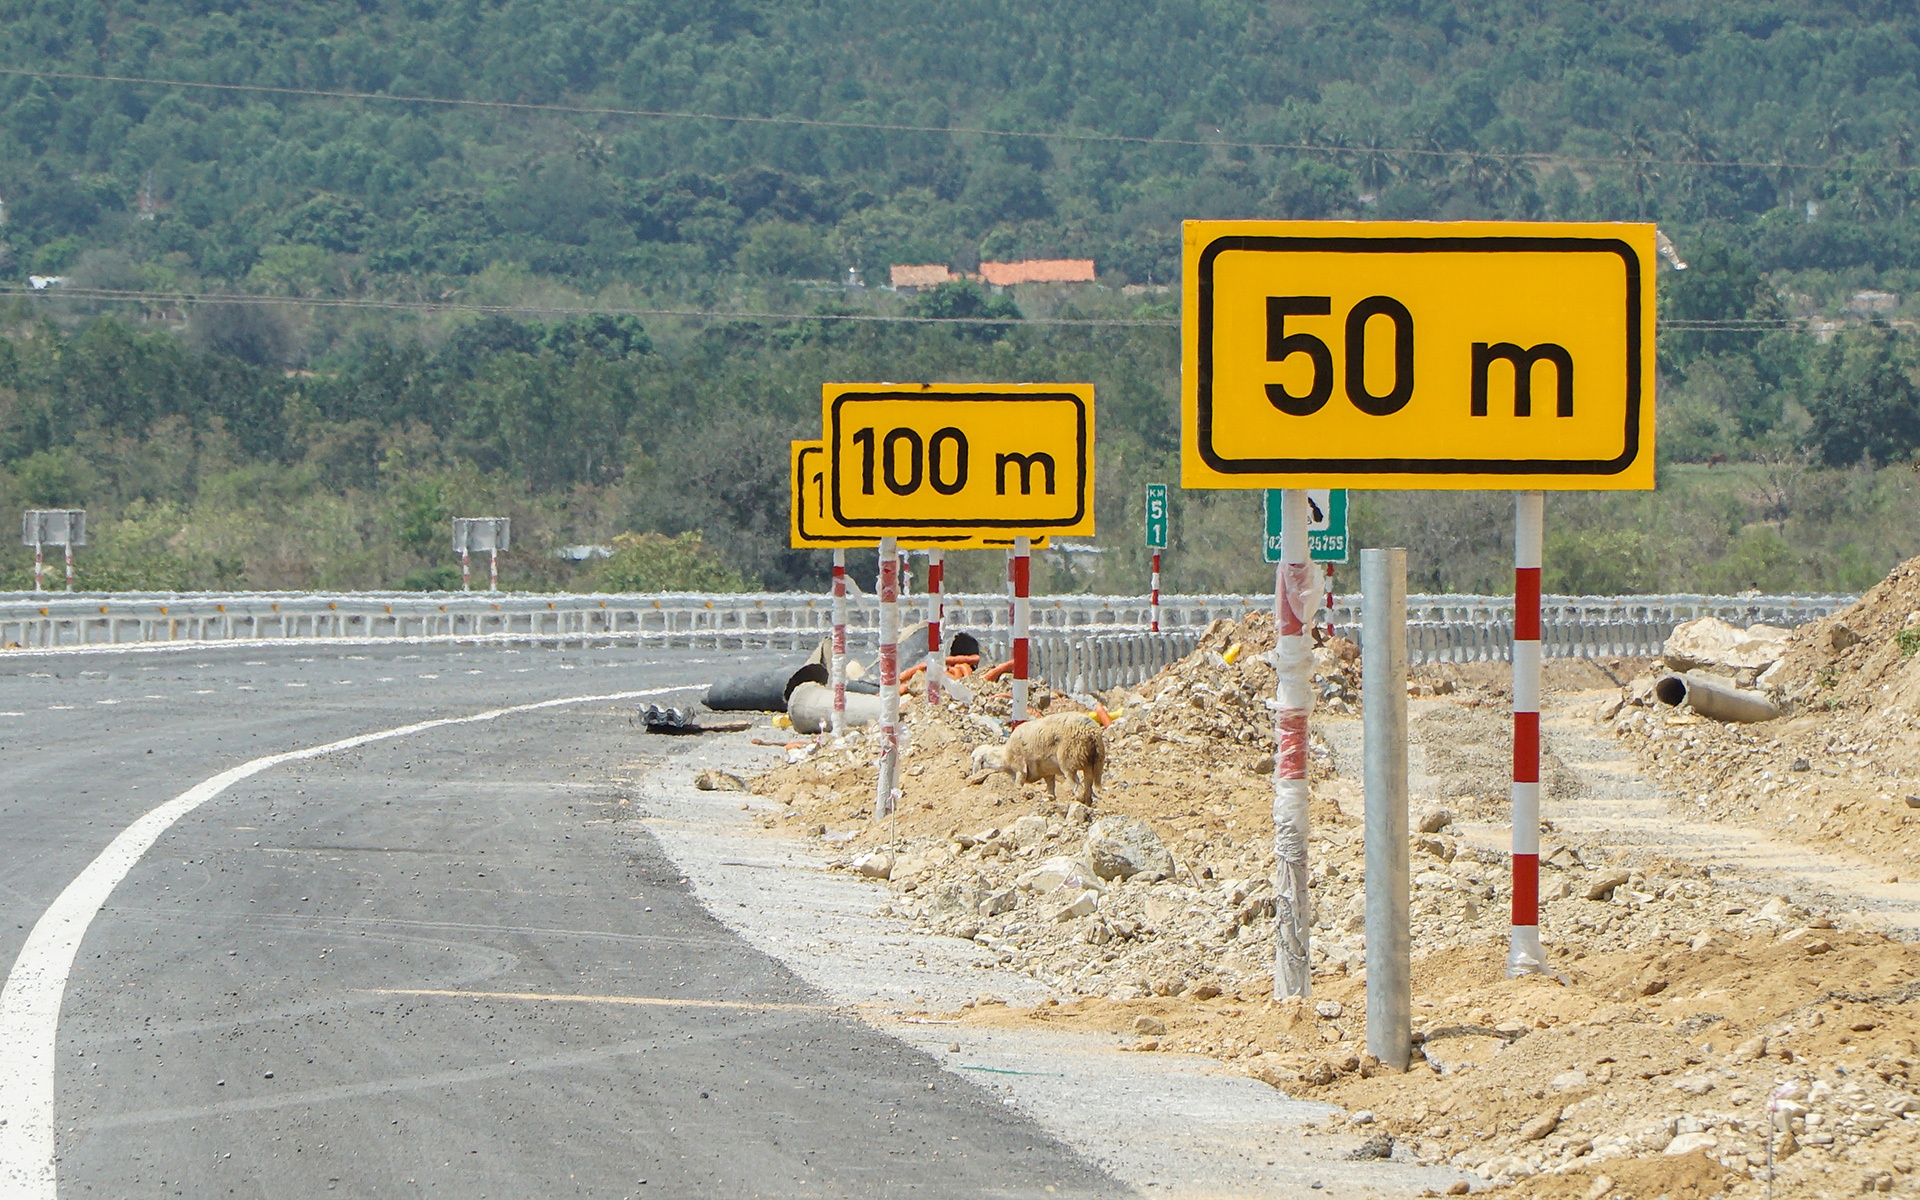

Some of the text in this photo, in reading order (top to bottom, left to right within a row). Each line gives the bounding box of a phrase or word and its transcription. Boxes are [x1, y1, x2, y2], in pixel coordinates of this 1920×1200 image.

[1265, 296, 1573, 417] 50 m
[853, 427, 968, 496] 100
[996, 452, 1055, 495] m
[1151, 500, 1163, 519] 5
[1153, 524, 1161, 543] 1
